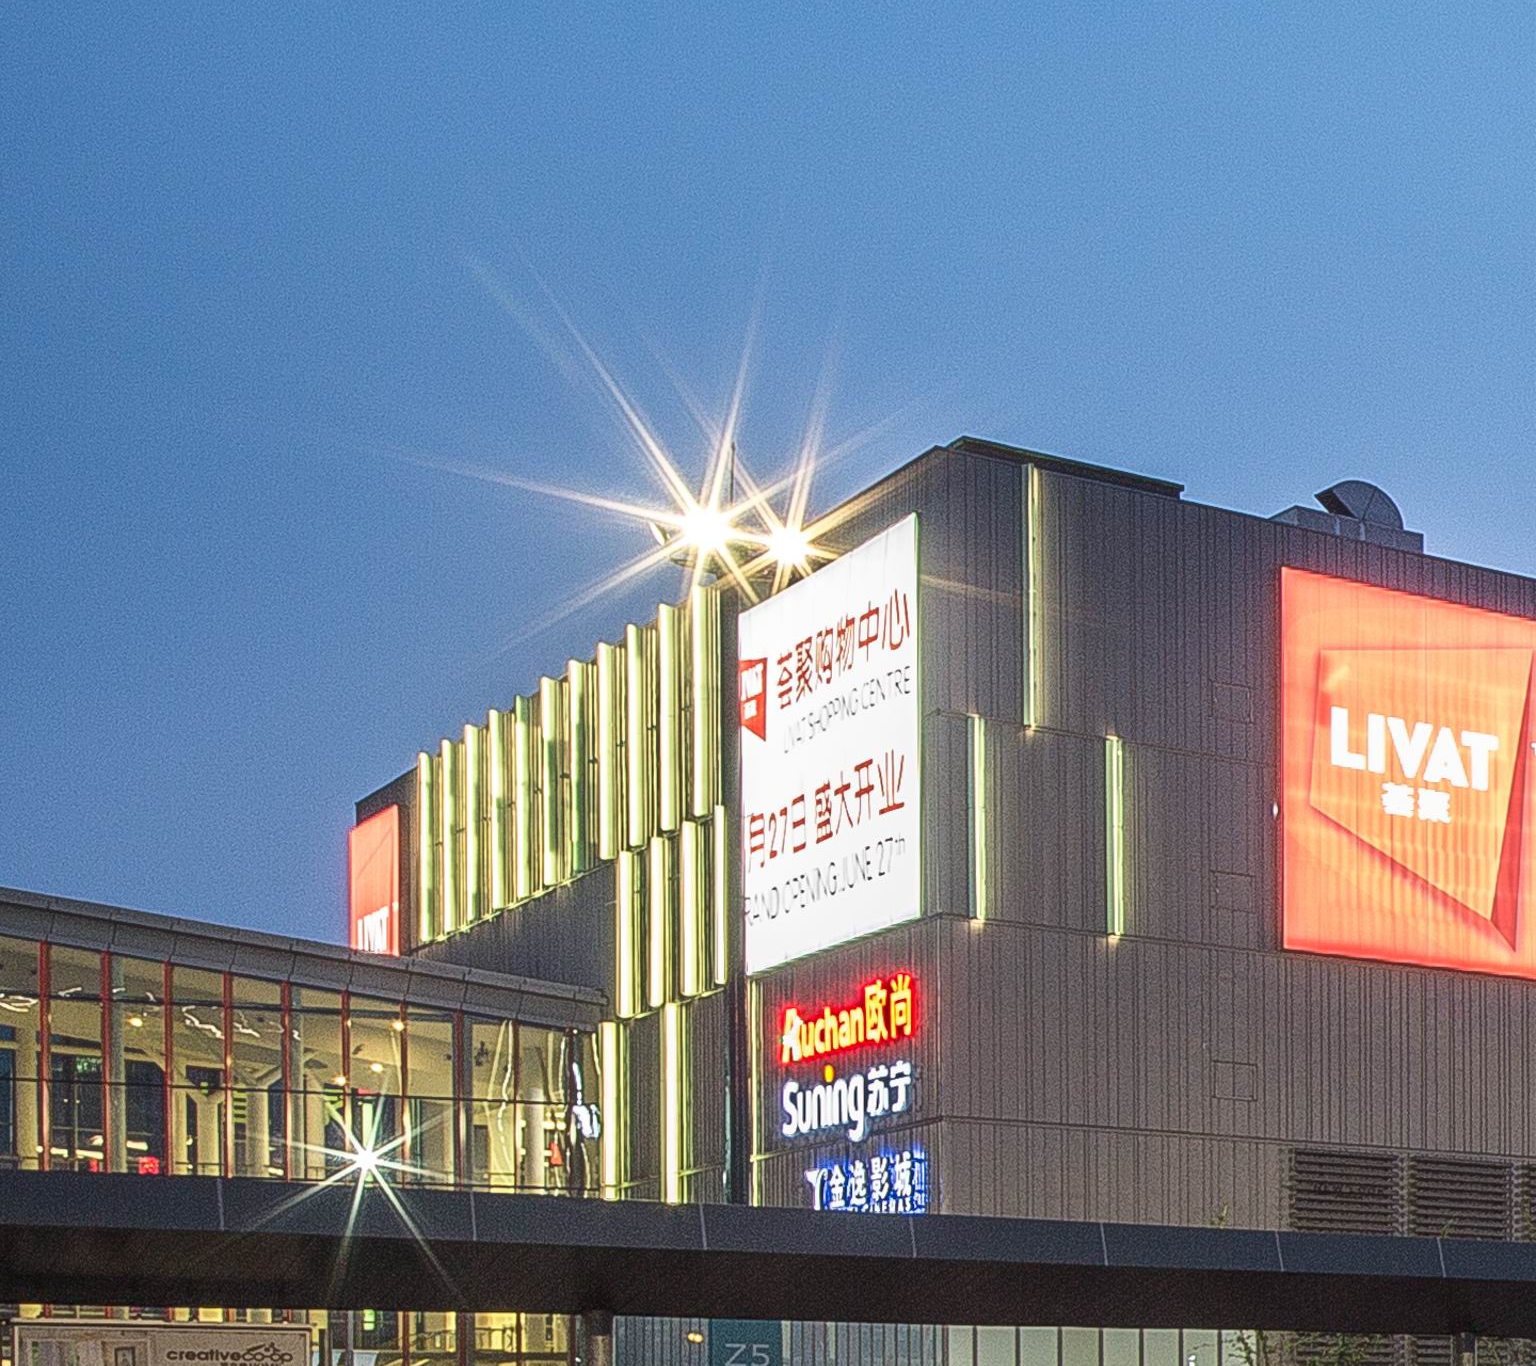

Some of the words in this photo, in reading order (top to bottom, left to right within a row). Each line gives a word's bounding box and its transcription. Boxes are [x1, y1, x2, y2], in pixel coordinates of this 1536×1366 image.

[776, 588, 910, 709] 荟聚购物中心
[860, 665, 911, 711] CENTRE
[1329, 706, 1500, 792] LIVAT
[814, 749, 904, 845] 盛大开业
[781, 1007, 864, 1064] Auchan
[865, 973, 912, 1042] 欧尚
[782, 1063, 865, 1143] Suning
[867, 1060, 911, 1118] 苏宁
